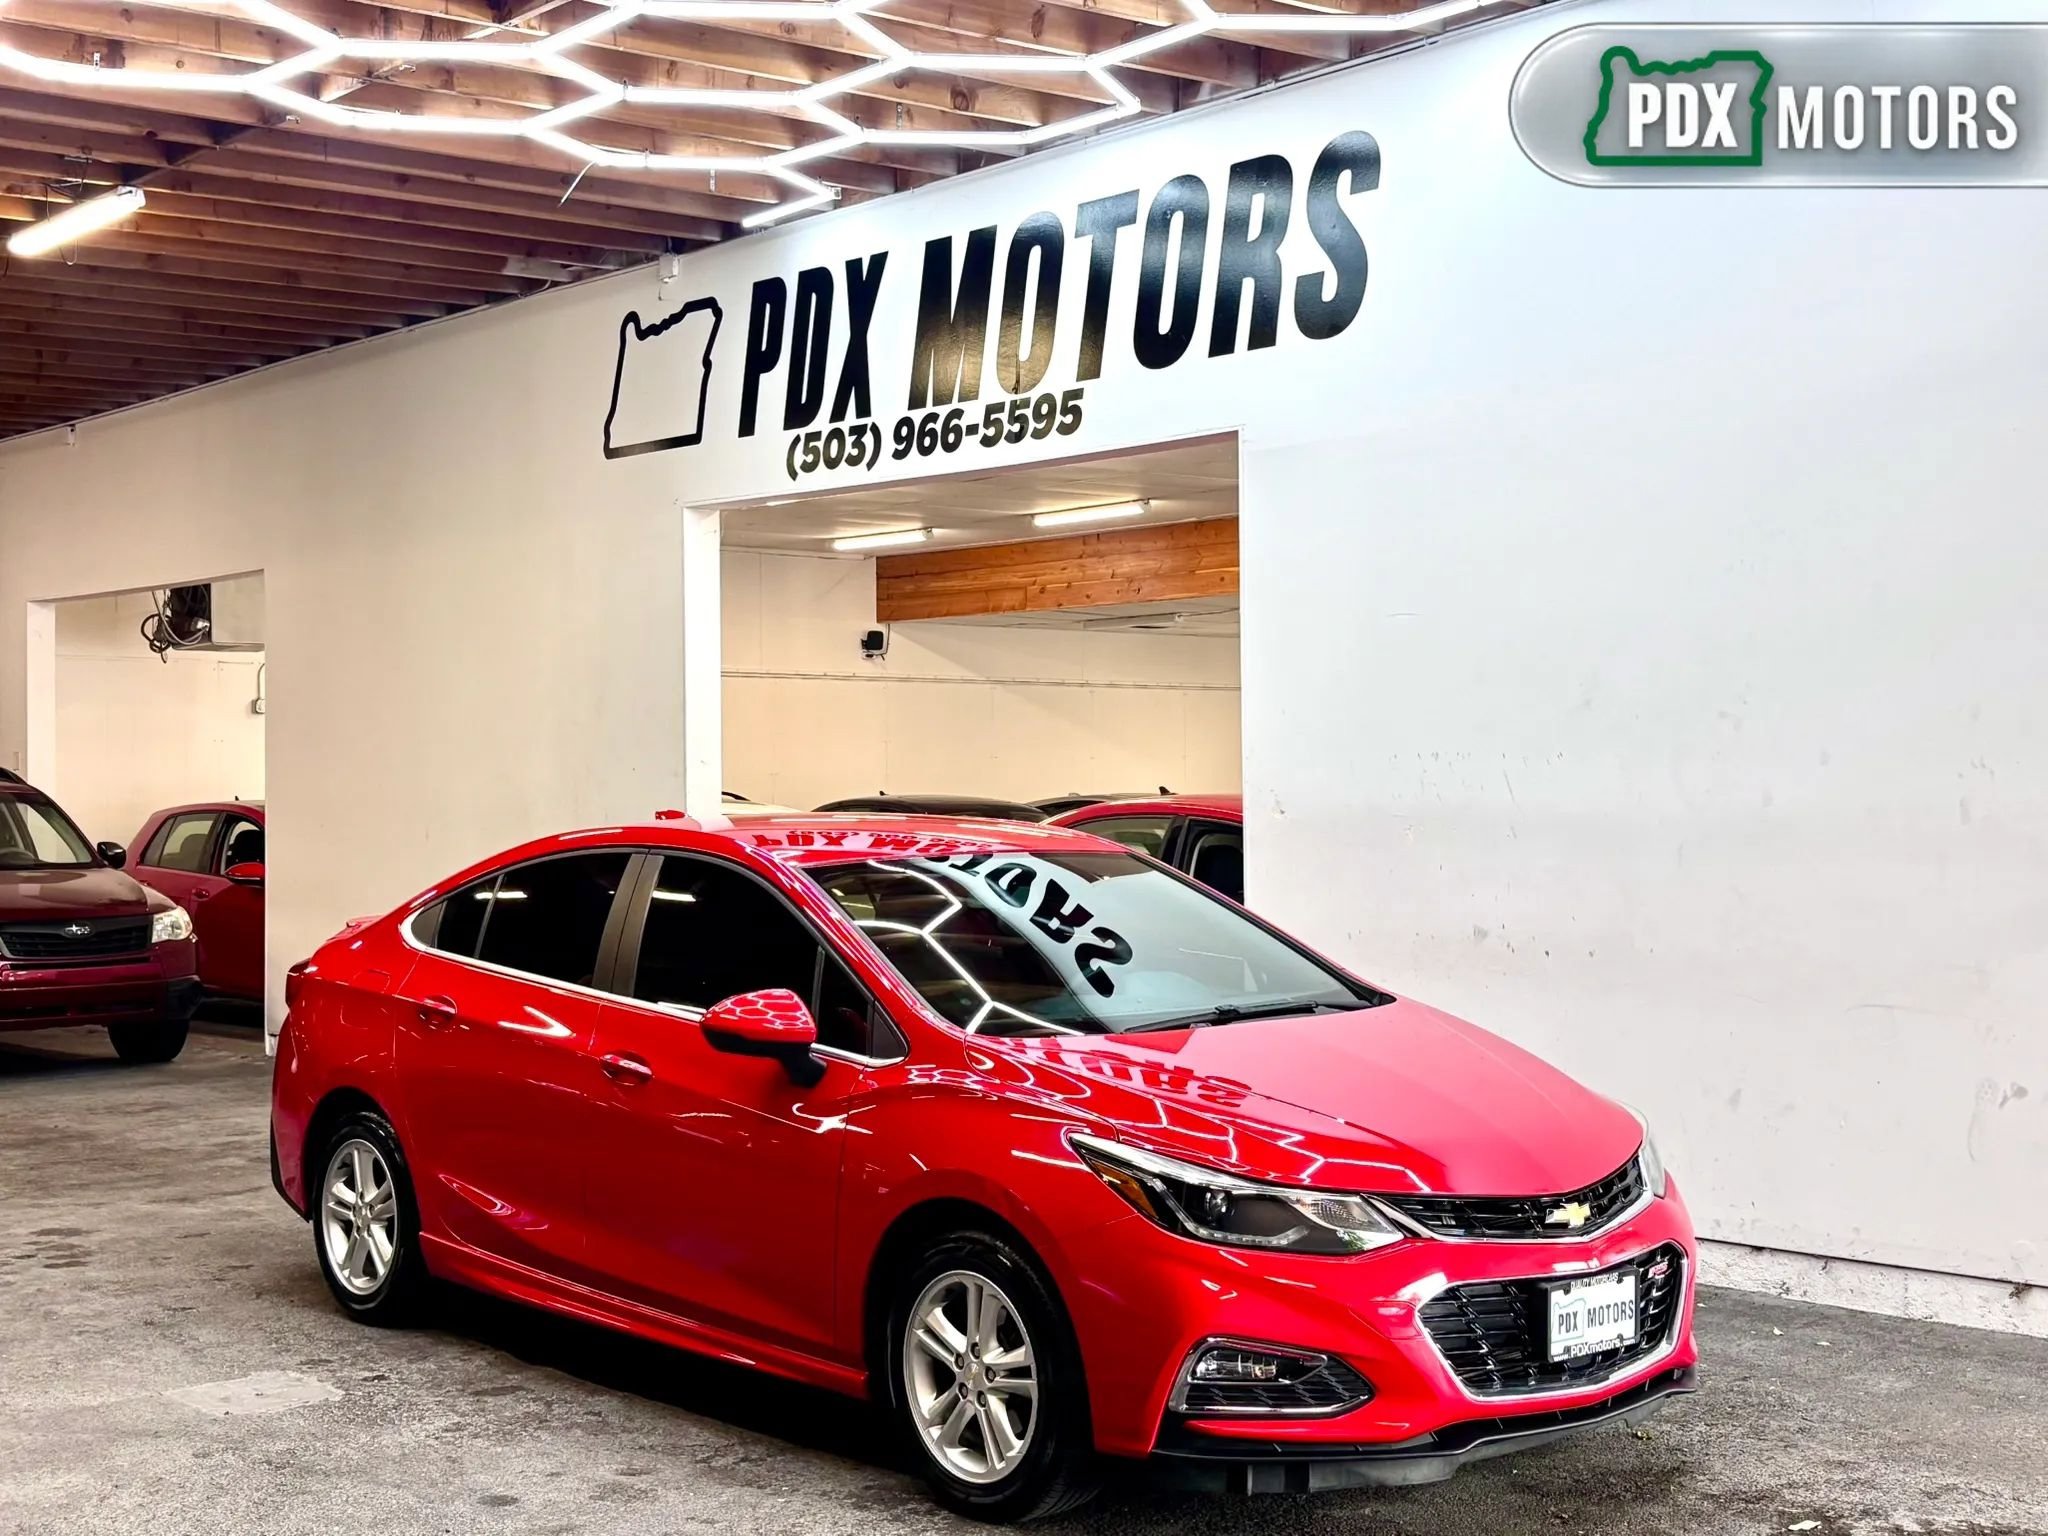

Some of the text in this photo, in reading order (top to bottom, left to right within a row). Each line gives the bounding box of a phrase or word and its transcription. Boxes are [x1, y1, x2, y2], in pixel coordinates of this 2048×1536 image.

[738, 129, 1382, 438] PDX MOTORS
[785, 387, 1085, 483] (503) 966-5595
[1558, 1299, 1635, 1335] PDX MOTORS
